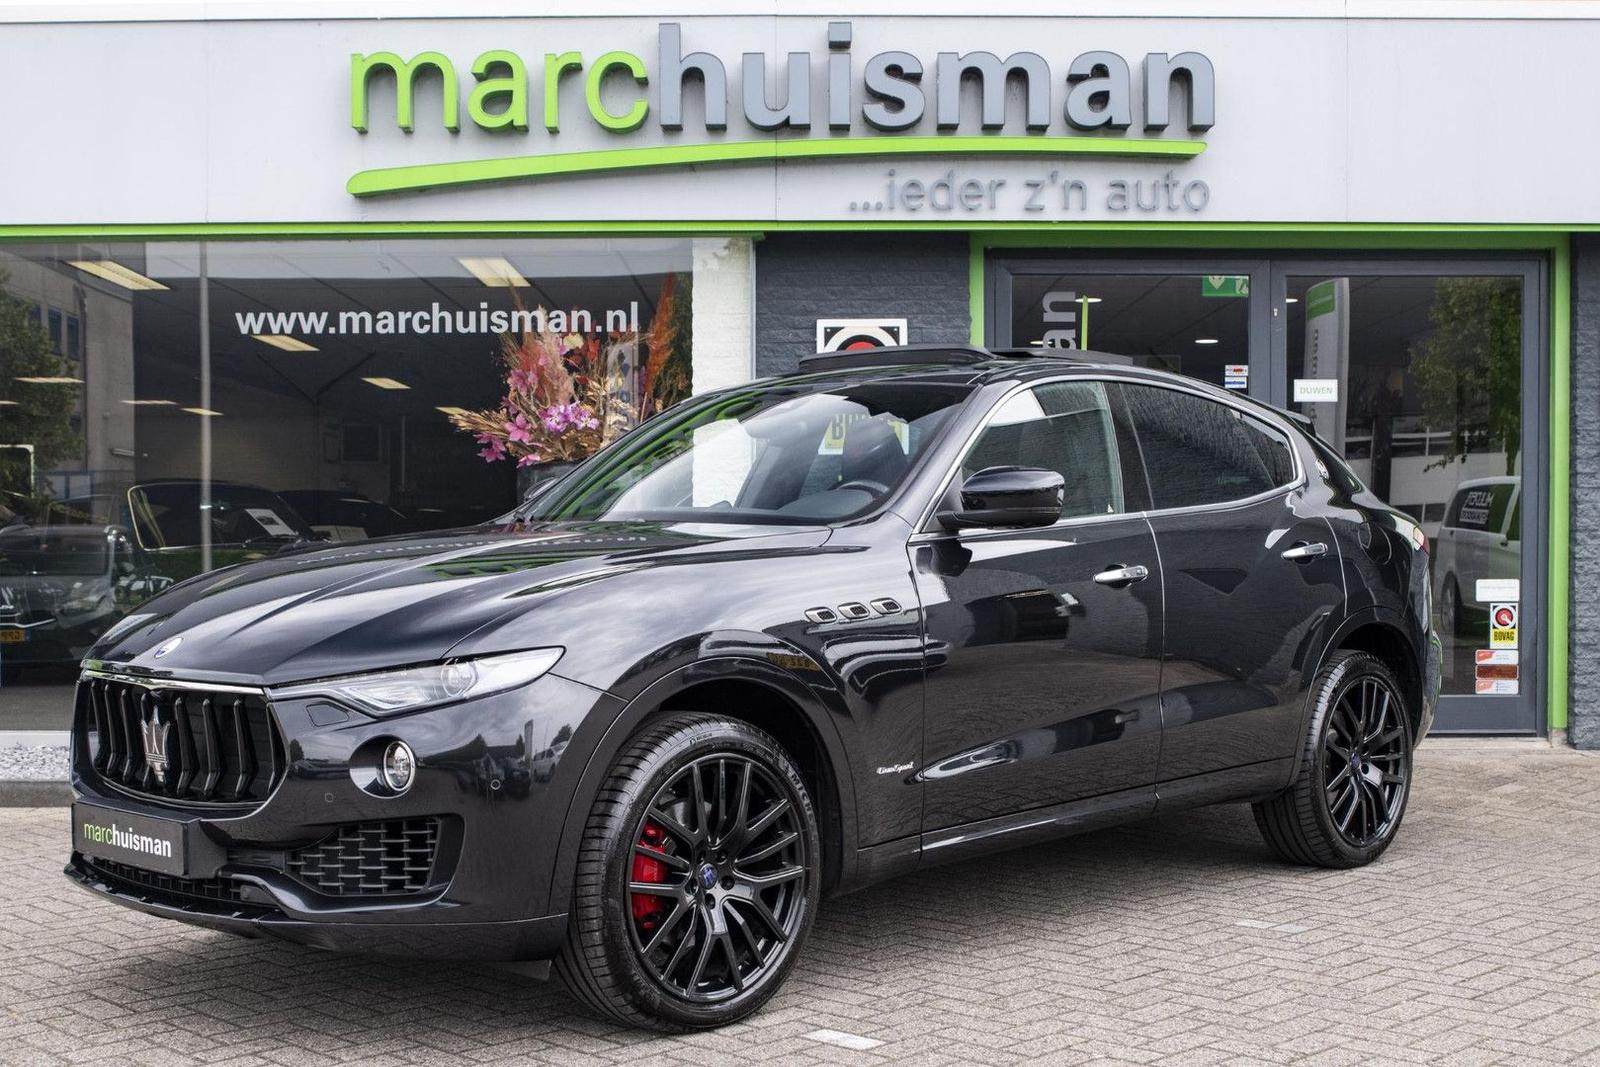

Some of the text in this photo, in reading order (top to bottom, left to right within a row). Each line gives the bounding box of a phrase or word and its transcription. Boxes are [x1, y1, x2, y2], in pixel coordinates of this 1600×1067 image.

[351, 22, 1216, 133] marchuisman
[1024, 170, 1088, 212] z'n
[1106, 170, 1212, 213] auto
[235, 300, 640, 335] www.marchuisman.nl
[1493, 631, 1515, 642] BOVAG
[83, 823, 172, 858] marchuisman
